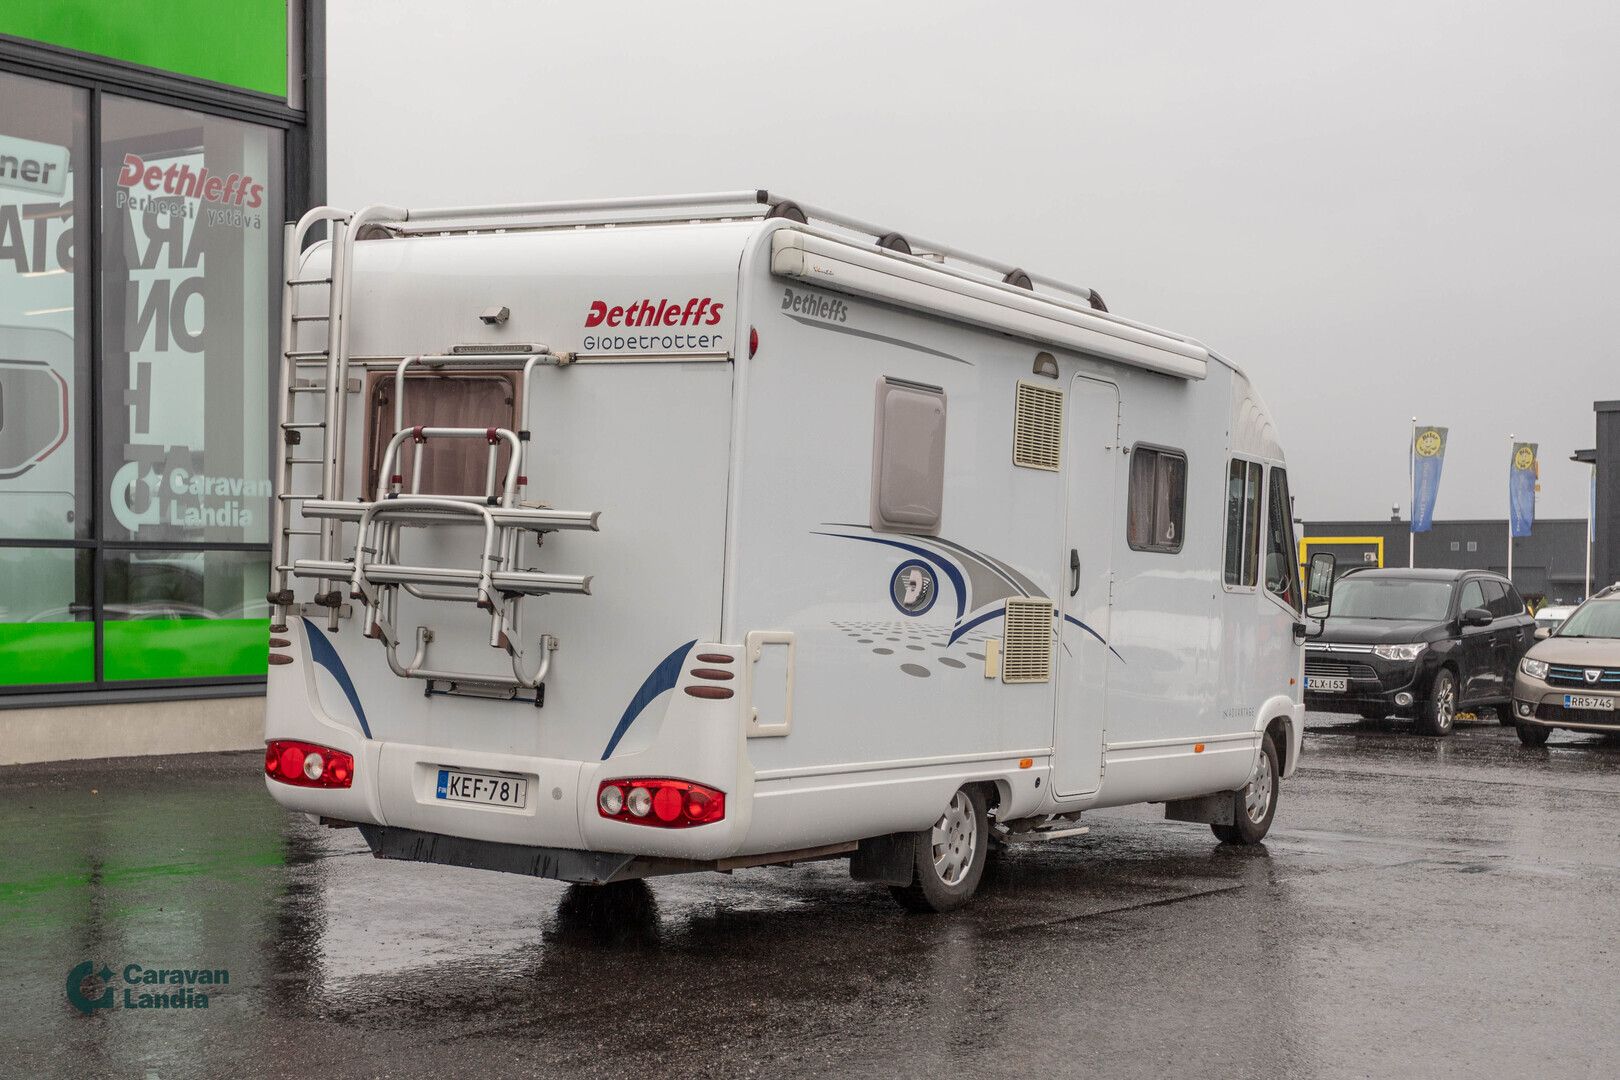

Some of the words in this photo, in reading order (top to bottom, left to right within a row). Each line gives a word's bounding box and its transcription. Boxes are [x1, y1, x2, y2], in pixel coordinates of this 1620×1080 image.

[117, 153, 264, 208] Dethleffs
[116, 190, 194, 219] Perheesi
[207, 208, 261, 230] ystävä
[584, 297, 724, 328] Dethleffs
[781, 288, 848, 322] Dethleffs
[583, 334, 723, 350] Globetrotter
[169, 467, 272, 497] Caravan
[170, 499, 253, 527] Landia
[1309, 679, 1345, 689] ZLX-153
[450, 775, 519, 803] KEF-781
